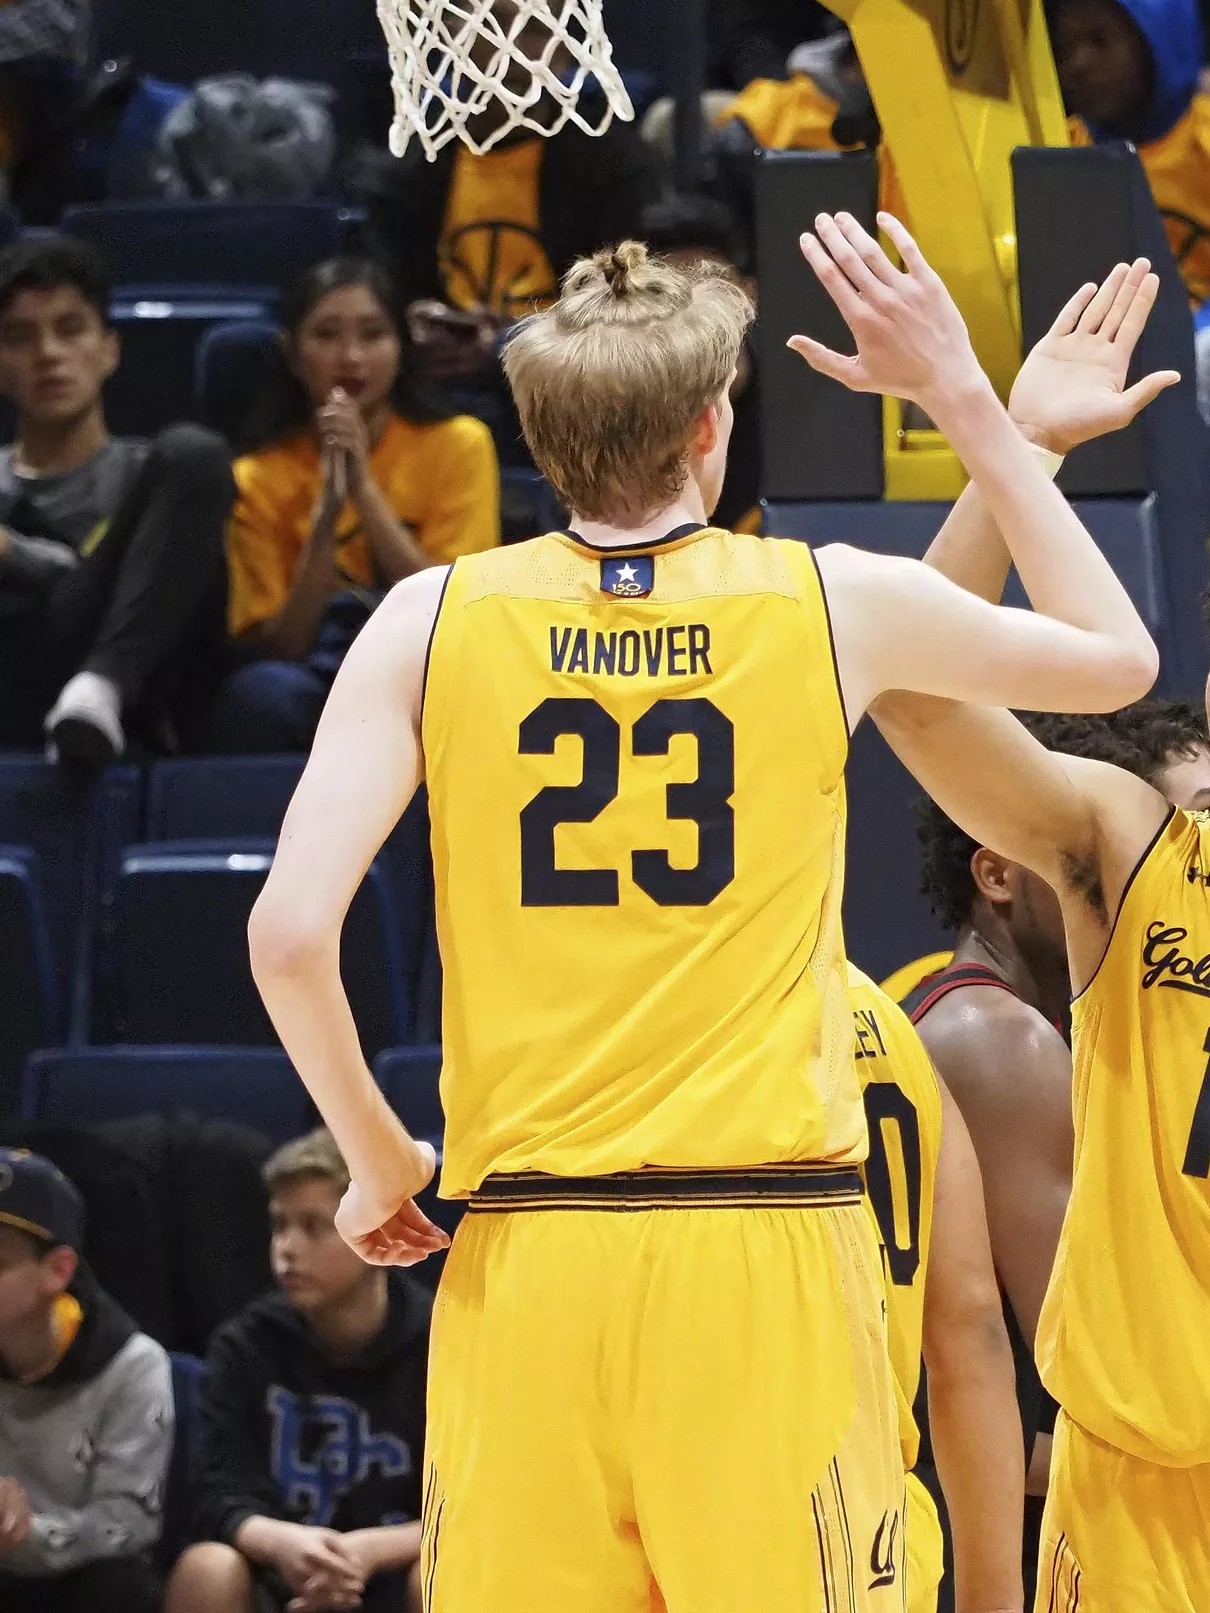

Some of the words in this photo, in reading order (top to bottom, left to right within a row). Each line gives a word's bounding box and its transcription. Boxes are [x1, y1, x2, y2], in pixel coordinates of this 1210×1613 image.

[549, 623, 714, 677] VANOVER
[517, 697, 735, 907] 23
[863, 1081, 921, 1286] 0
